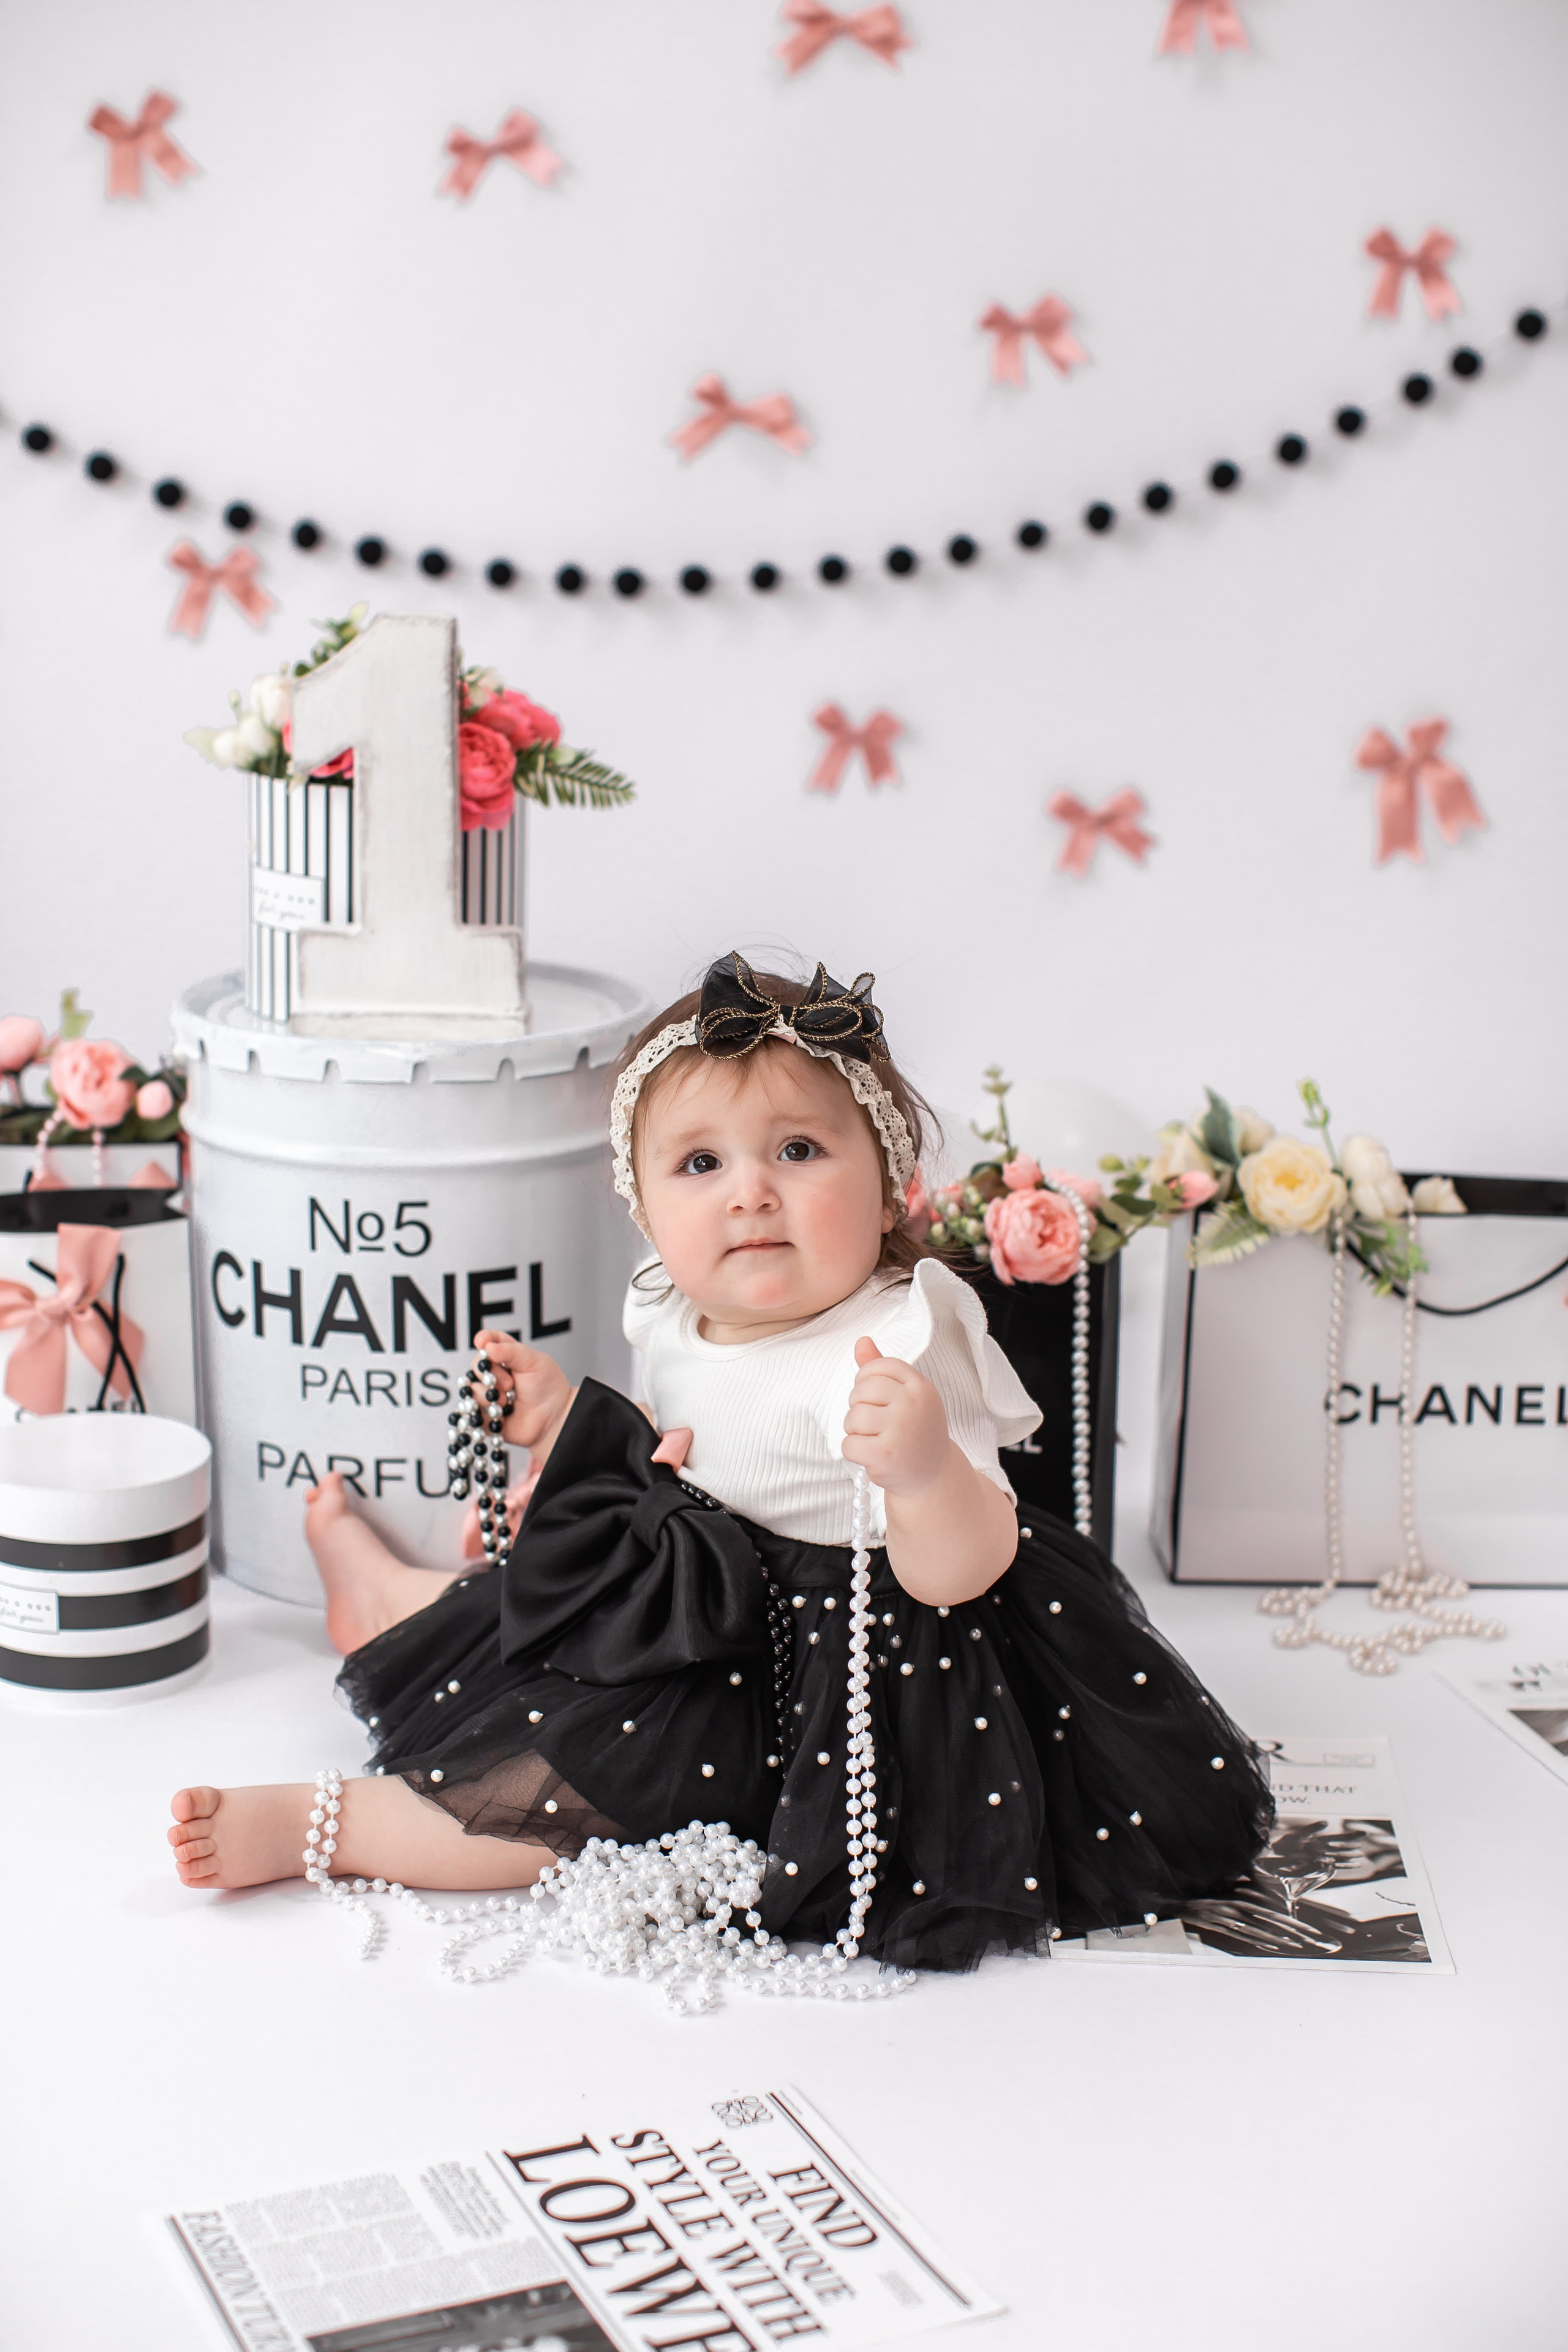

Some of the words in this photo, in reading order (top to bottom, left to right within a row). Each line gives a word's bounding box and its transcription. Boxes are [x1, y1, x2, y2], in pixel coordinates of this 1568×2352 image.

[211, 1250, 573, 1354] CHANEL
[300, 1363, 451, 1408] PARIS
[1297, 1784, 1358, 1795] THAT
[609, 2128, 736, 2240] STYLE
[705, 2237, 828, 2346] WITH
[692, 2136, 768, 2209] YOUR
[750, 2207, 856, 2305] UNIQUE
[766, 2161, 880, 2251] FIND
[182, 2210, 267, 2301] FASHION
